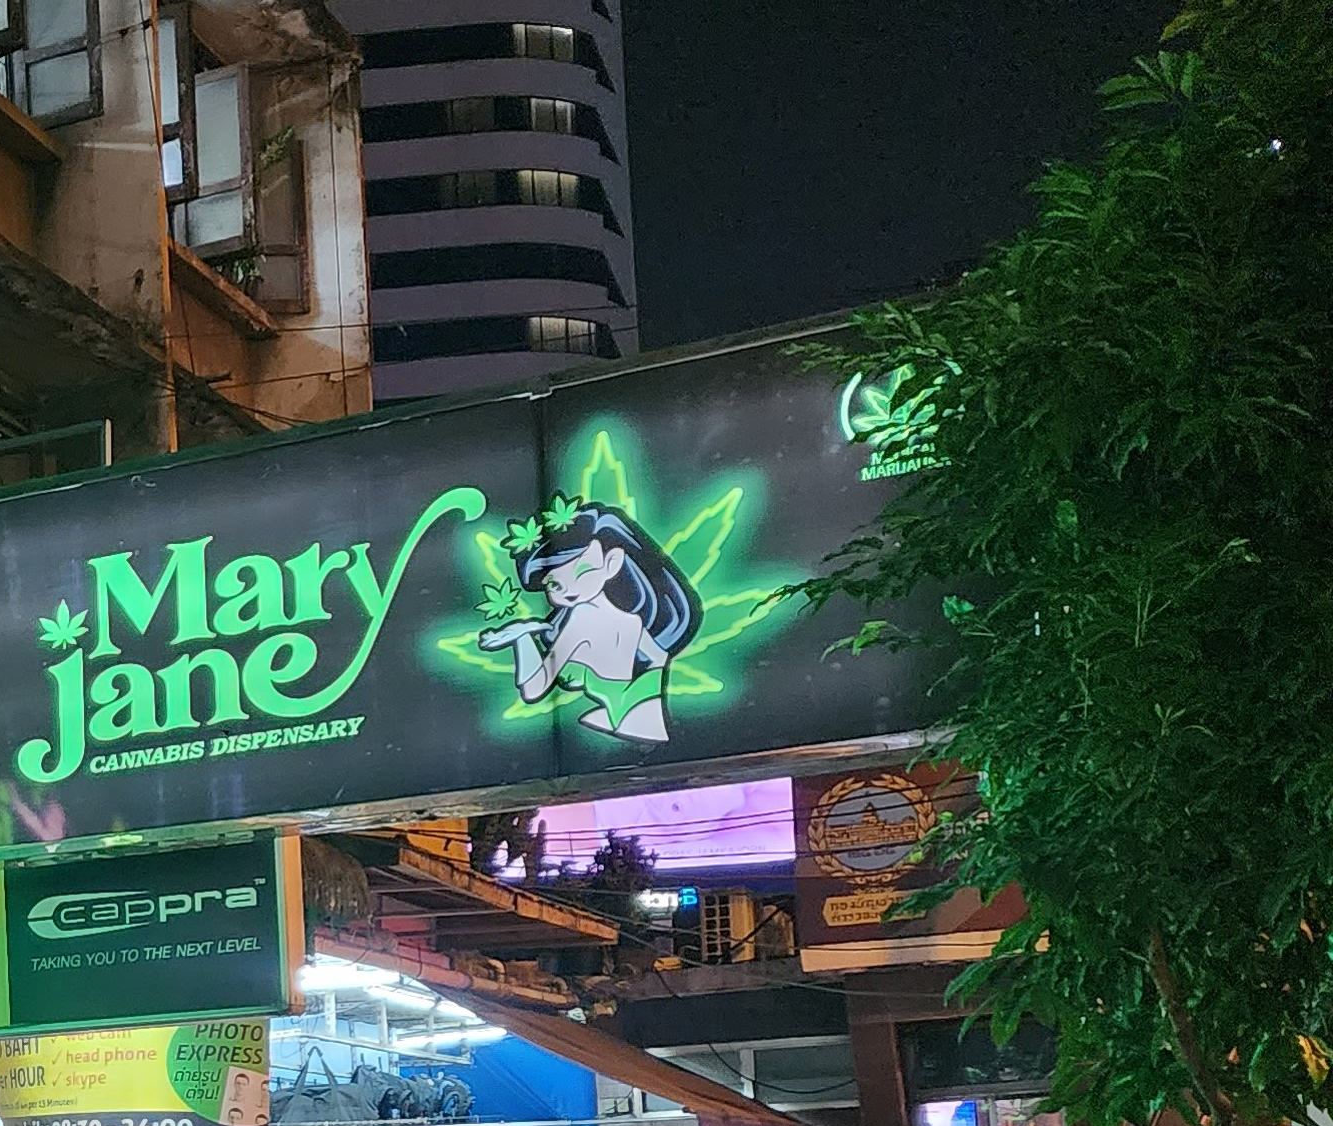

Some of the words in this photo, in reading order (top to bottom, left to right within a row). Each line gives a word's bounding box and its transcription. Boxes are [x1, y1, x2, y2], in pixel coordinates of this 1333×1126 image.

[87, 487, 487, 662] Mary
[89, 740, 205, 775] CANNABIS
[210, 716, 367, 757] DISPENSARY
[60, 886, 259, 925] cappra
[31, 953, 81, 972] TAKING
[85, 950, 116, 967] YOU
[120, 948, 139, 964] TO
[144, 945, 172, 961] THE
[176, 940, 214, 958] NEXT
[217, 936, 261, 955] LEVEL
[195, 1022, 264, 1042] PHOTO
[65, 1050, 100, 1065] head
[104, 1048, 158, 1067] phone
[176, 1044, 264, 1065] EXPRESS
[10, 1065, 46, 1089] HOUR
[65, 1072, 107, 1090] skype
